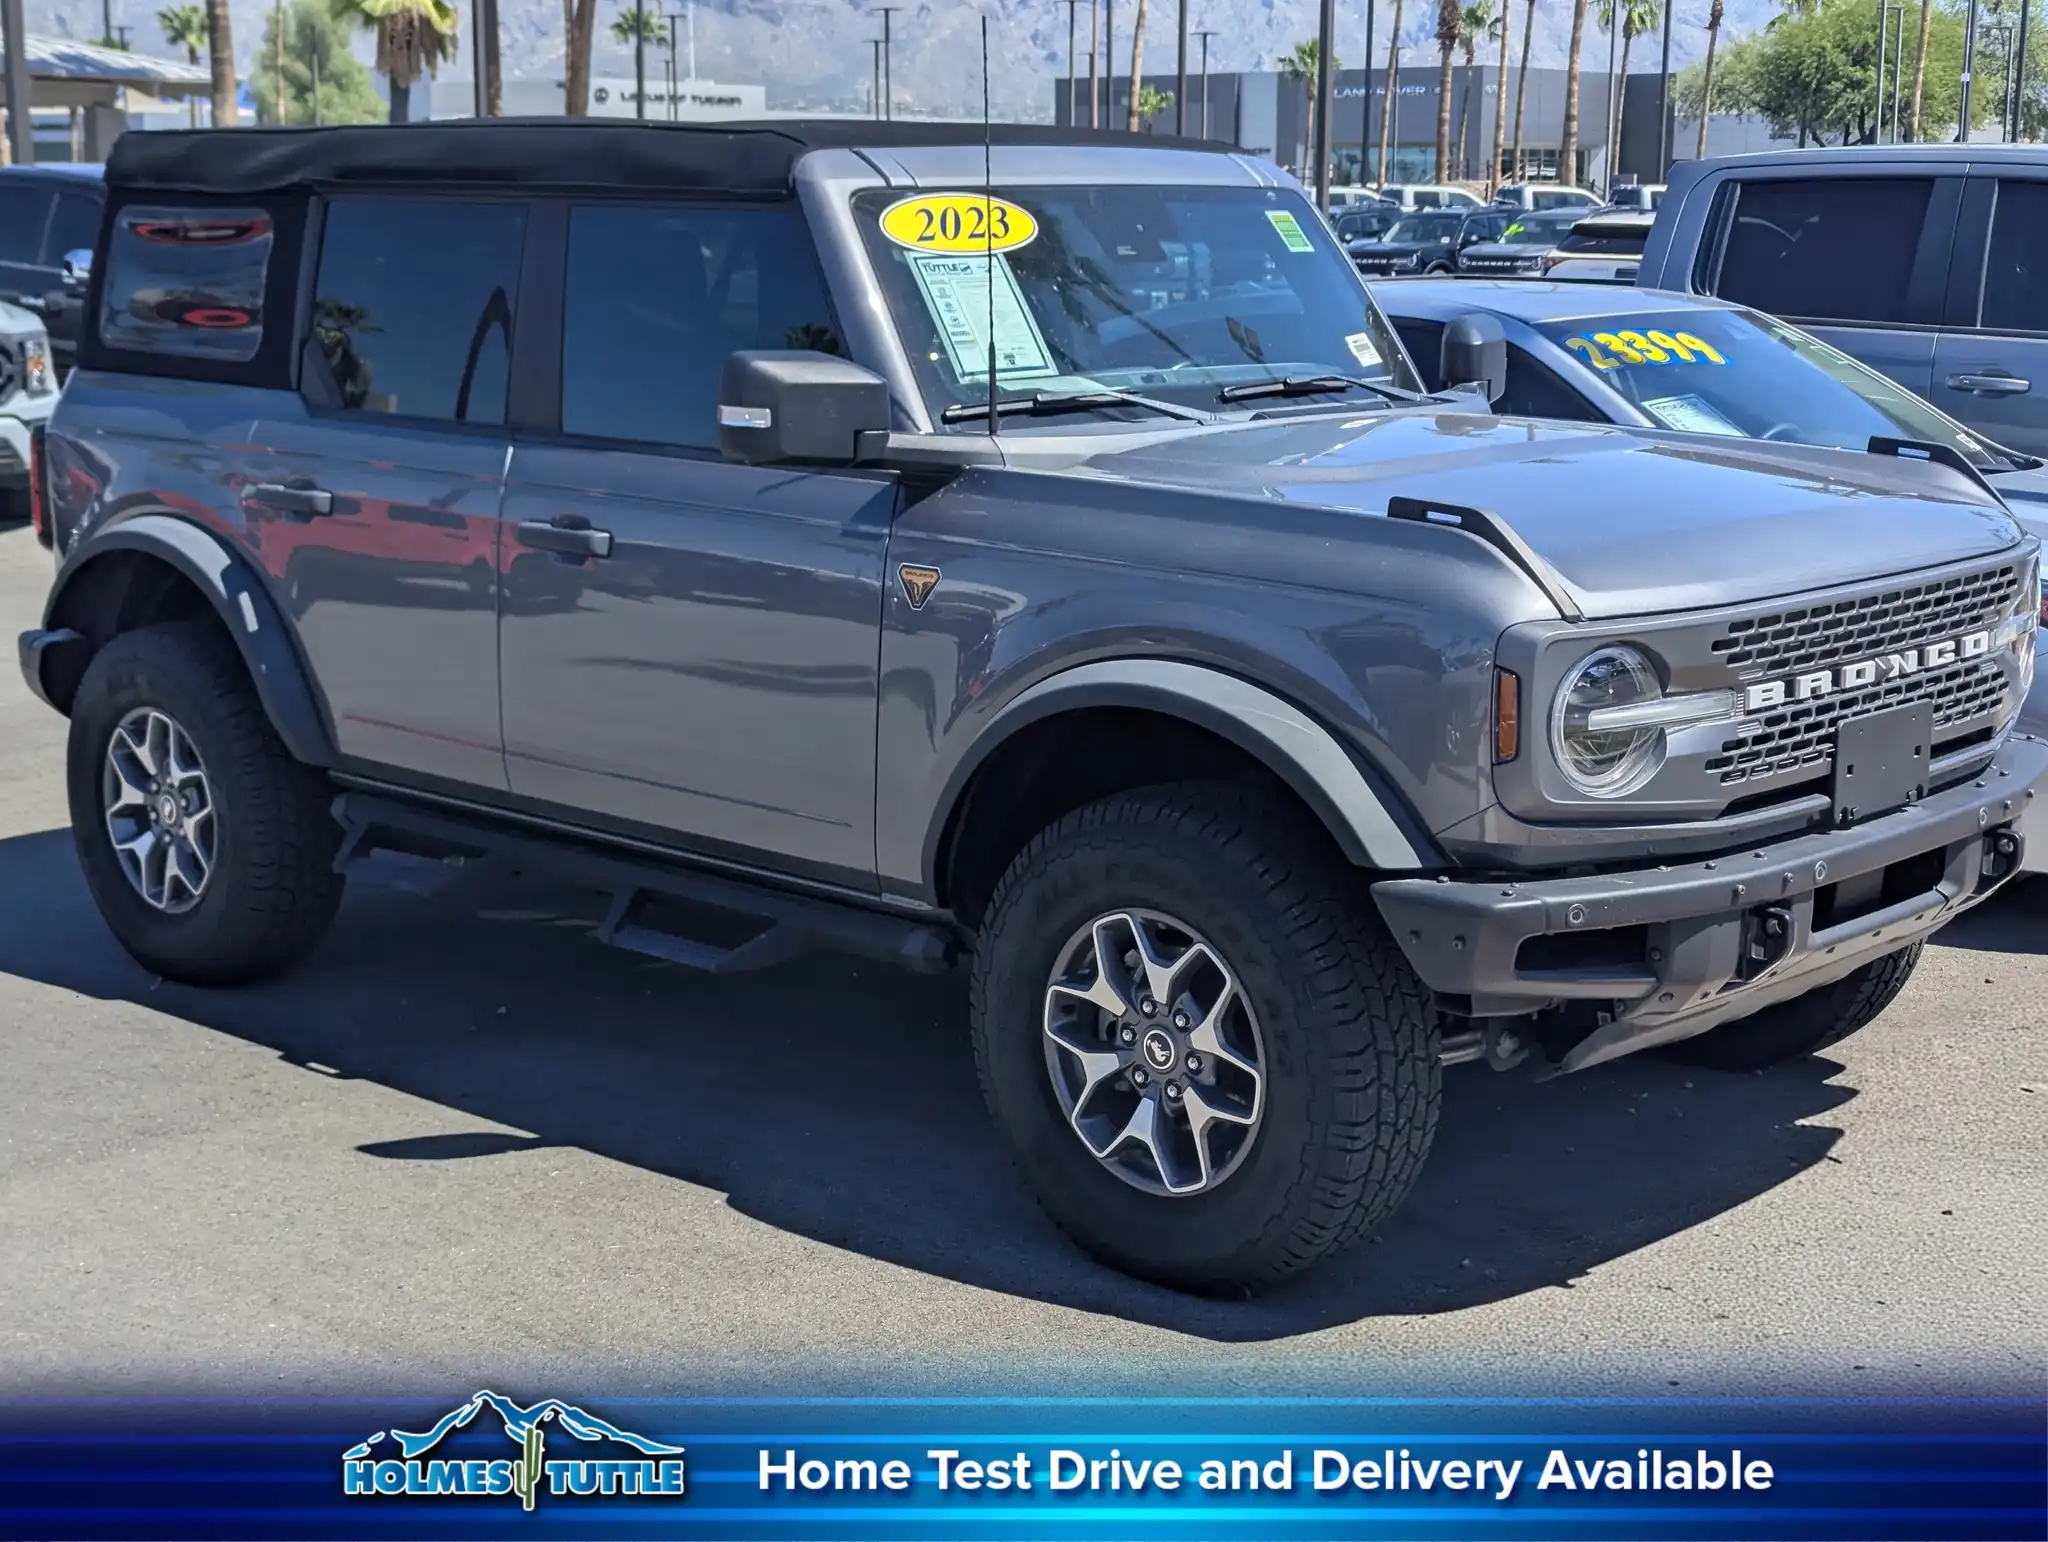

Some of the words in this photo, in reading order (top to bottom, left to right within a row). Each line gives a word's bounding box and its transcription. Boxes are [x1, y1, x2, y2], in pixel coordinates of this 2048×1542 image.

[1333, 87, 1372, 98] LAN
[1377, 86, 1426, 96] RVER
[914, 206, 1010, 242] 2023
[1745, 630, 1989, 710] BRONCO
